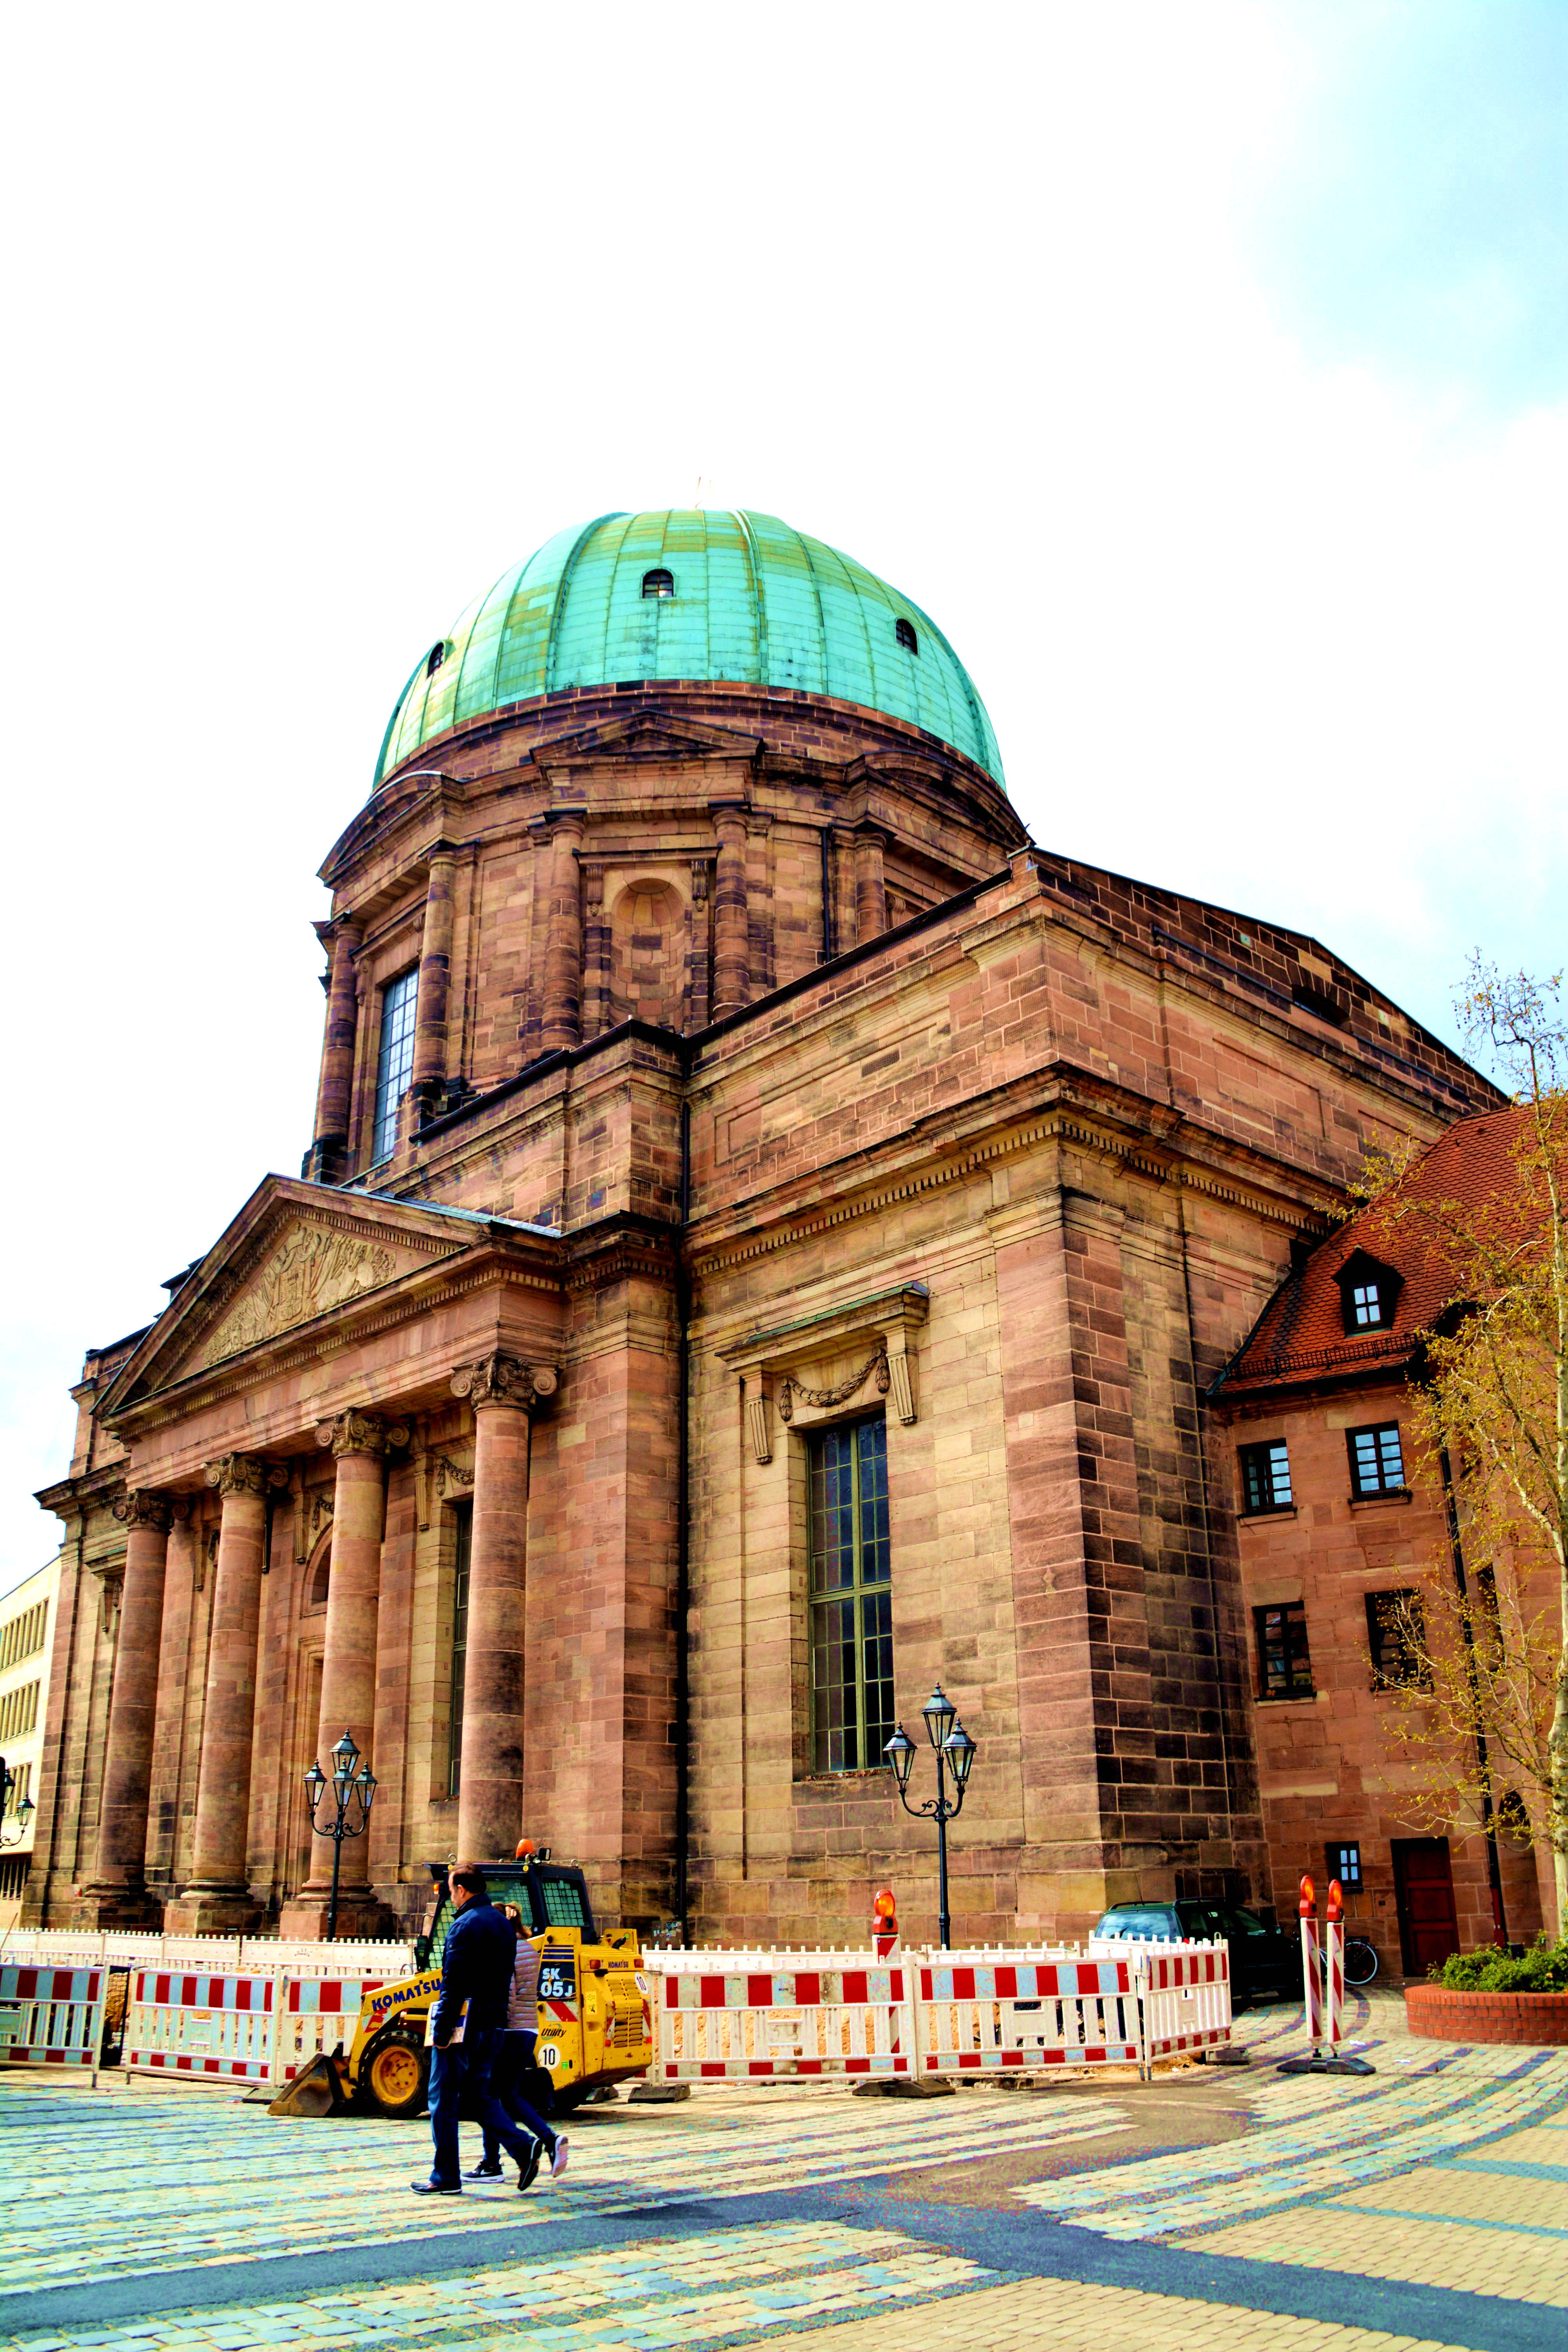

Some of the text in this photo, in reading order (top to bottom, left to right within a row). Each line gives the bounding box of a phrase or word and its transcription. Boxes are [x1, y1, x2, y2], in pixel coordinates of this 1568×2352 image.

[608, 1959, 628, 1968] KOMATSU
[542, 1968, 560, 1980] SK
[637, 1976, 646, 1991] 10
[372, 1978, 441, 2011] KOMATSU
[541, 2028, 567, 2038] Utility
[543, 2048, 555, 2065] 10
